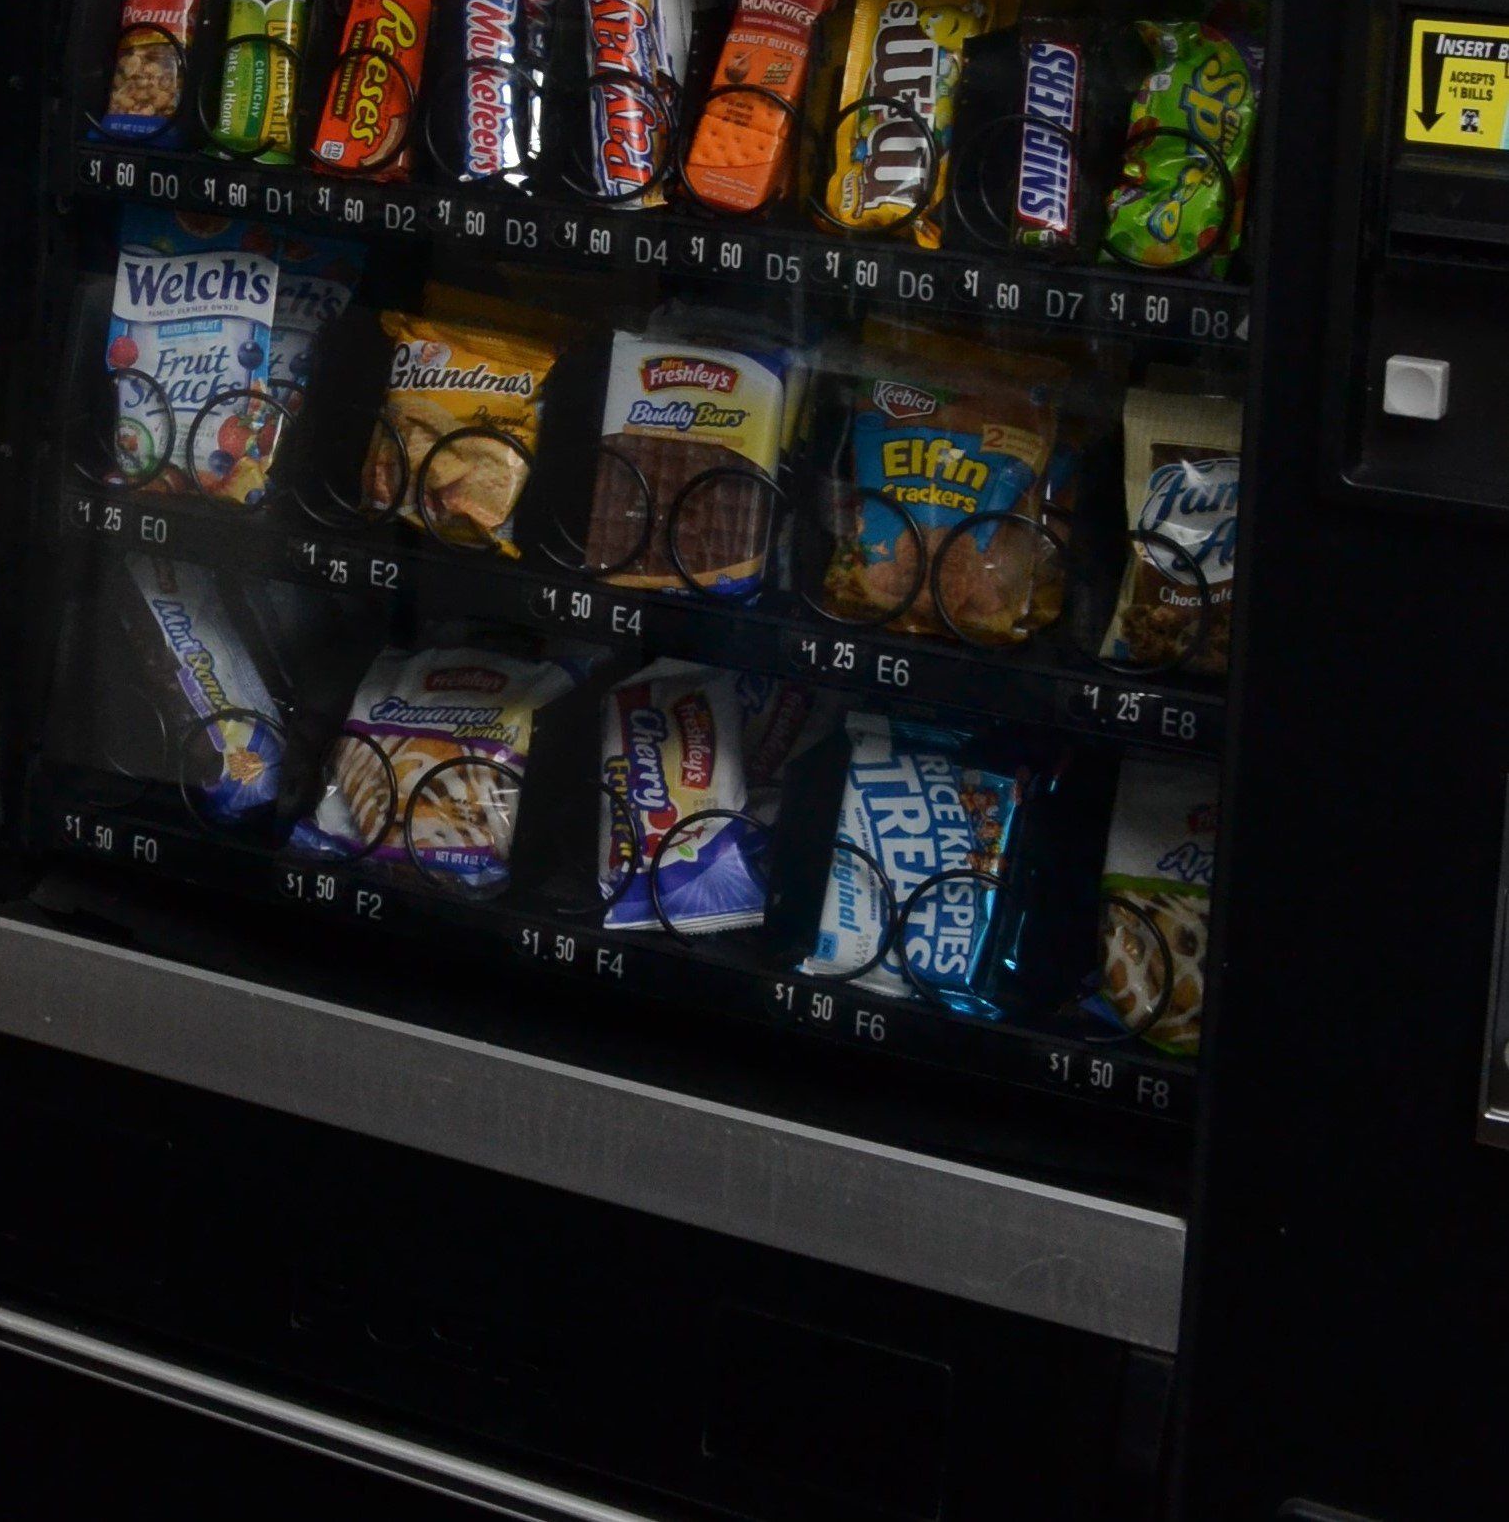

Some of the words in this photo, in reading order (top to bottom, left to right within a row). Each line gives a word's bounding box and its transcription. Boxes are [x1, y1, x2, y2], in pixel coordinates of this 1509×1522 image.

[767, 37, 810, 58] BUTTER
[1435, 32, 1495, 59] INSERT
[251, 60, 265, 119] CRUNCHY
[1448, 86, 1458, 99] $1
[1460, 88, 1494, 101] BILLS
[1449, 70, 1496, 87] ACCEPTS
[220, 92, 237, 135] Honey
[1020, 43, 1079, 228] SNICKERS
[89, 159, 136, 190] $1.60
[150, 170, 179, 199] D0
[203, 177, 247, 208] $1.60
[265, 187, 292, 214] D1
[318, 187, 364, 223] $1.60
[385, 203, 417, 232] D2
[438, 200, 485, 238] $1.60
[505, 218, 538, 248] D3
[564, 221, 611, 256] $1.60
[635, 237, 669, 266] D4
[690, 236, 742, 273] $1.60
[766, 253, 801, 284] D5
[124, 258, 271, 307] Welch's
[825, 251, 878, 290] $1.60
[898, 270, 935, 302] D6
[964, 269, 1019, 311] $1.60
[1045, 289, 1084, 319] D7
[1109, 292, 1170, 328] $1.60
[1190, 306, 1229, 340] D8
[153, 345, 230, 378] Fruit
[389, 342, 534, 396] Grandma's
[649, 362, 731, 391] Freshley's
[471, 405, 532, 428] Peanut
[628, 401, 695, 430] Buddy
[694, 402, 746, 427] Bars
[875, 383, 935, 412] Keebler
[984, 427, 1006, 449] 2
[882, 438, 990, 491] Elfin
[77, 500, 122, 531] $1.25
[141, 515, 168, 544] E0
[303, 542, 348, 584] $1.25
[370, 559, 399, 590] E2
[542, 587, 592, 621] $1.50
[612, 605, 641, 636] E4
[801, 639, 855, 671] $1.25
[876, 653, 910, 687] E6
[369, 697, 504, 725] Cinnamon
[1083, 684, 1141, 724] $1.25
[1161, 707, 1196, 741] E8
[629, 707, 668, 810] Cherry
[678, 701, 712, 786] Freshley's
[914, 753, 967, 831] RICE
[64, 814, 113, 850] $1.50
[132, 835, 158, 864] F0
[851, 754, 938, 972] TREATS
[286, 873, 336, 904] $1.50
[356, 889, 383, 921] F2
[932, 828, 977, 976] KRISPIES
[521, 928, 576, 963] $1.50
[596, 948, 624, 980] F4
[774, 982, 833, 1021] $1.50
[855, 1010, 887, 1042] F6
[1049, 1052, 1113, 1089] $1.50
[1136, 1076, 1170, 1109] F8
